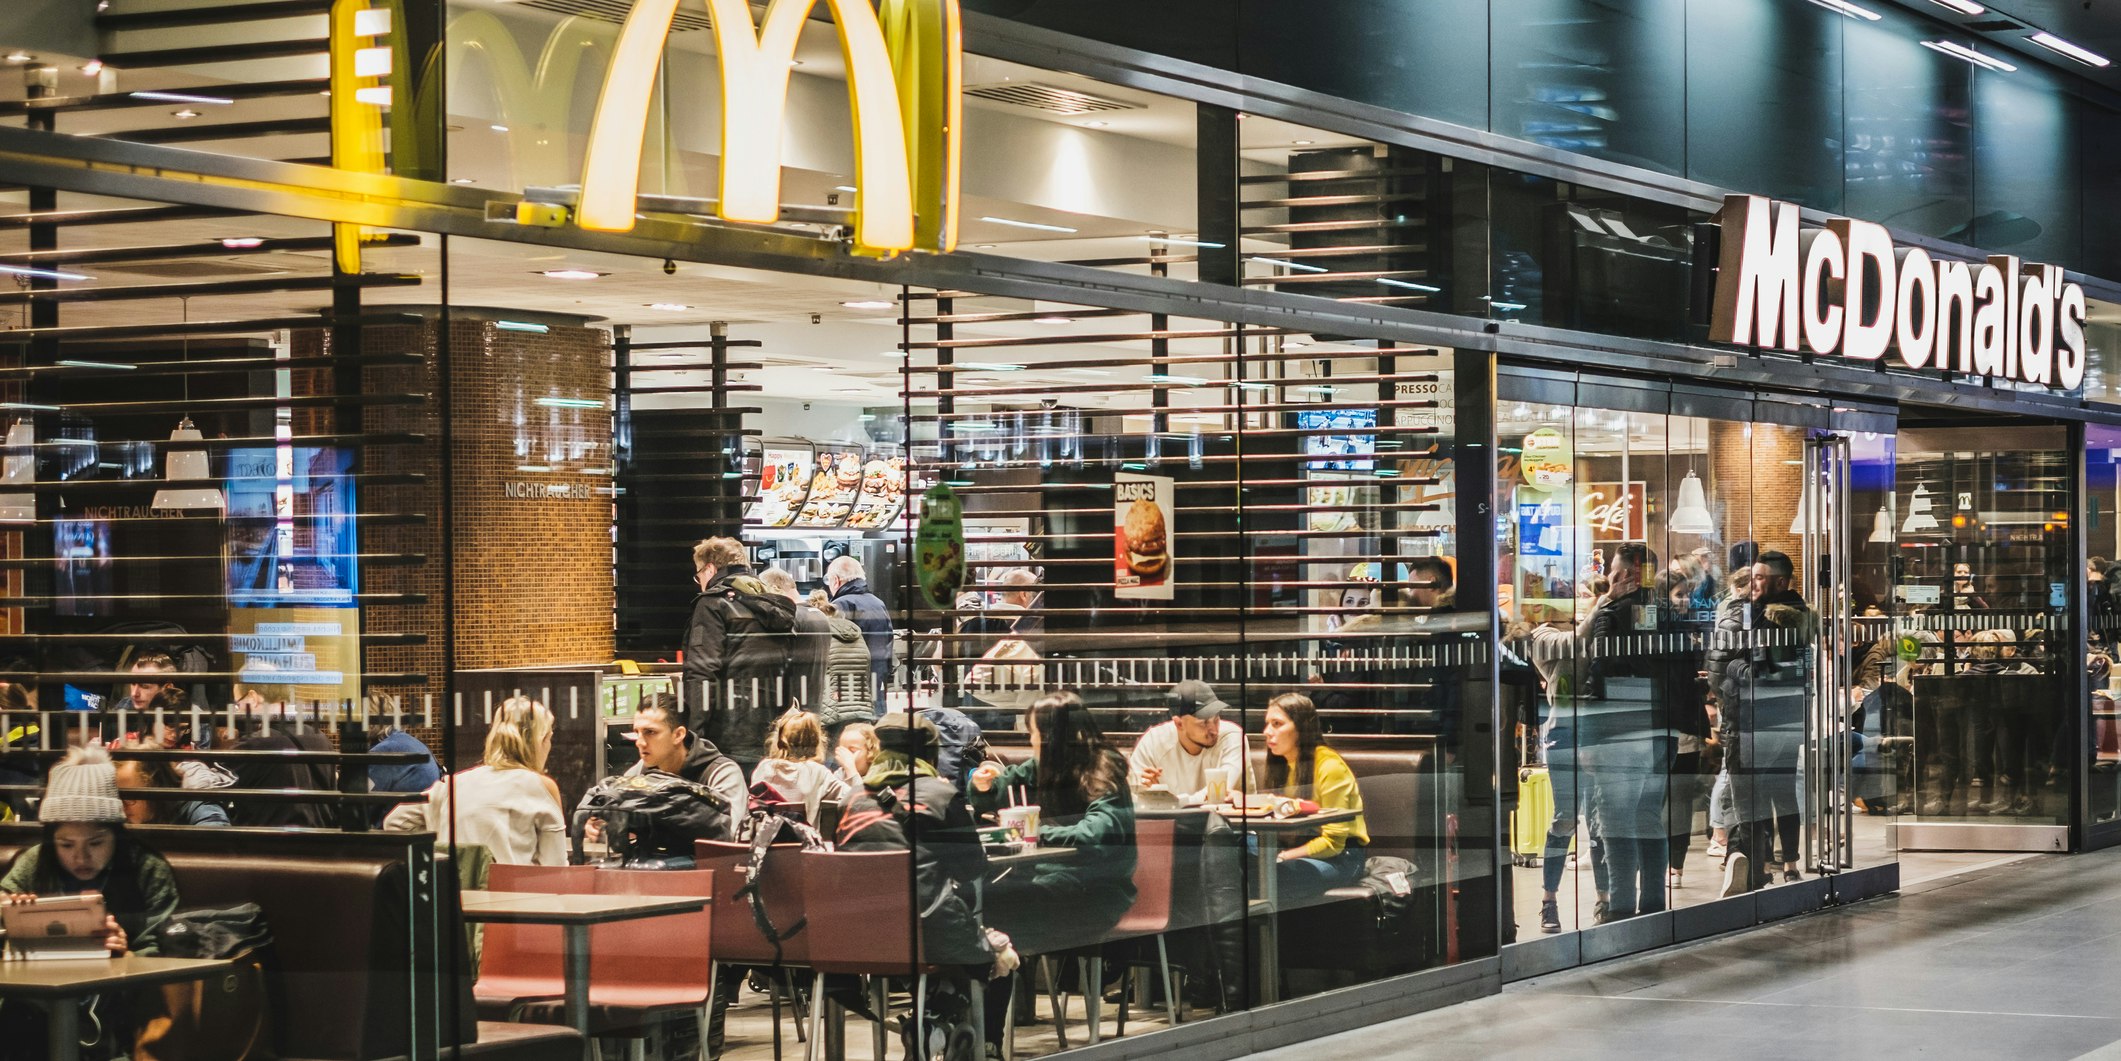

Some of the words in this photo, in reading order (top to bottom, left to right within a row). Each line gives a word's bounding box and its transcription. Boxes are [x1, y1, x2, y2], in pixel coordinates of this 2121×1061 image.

[1732, 195, 2086, 391] McDonald's
[505, 482, 590, 498] NICHTRAUCHER
[1117, 483, 1154, 501] BASICS
